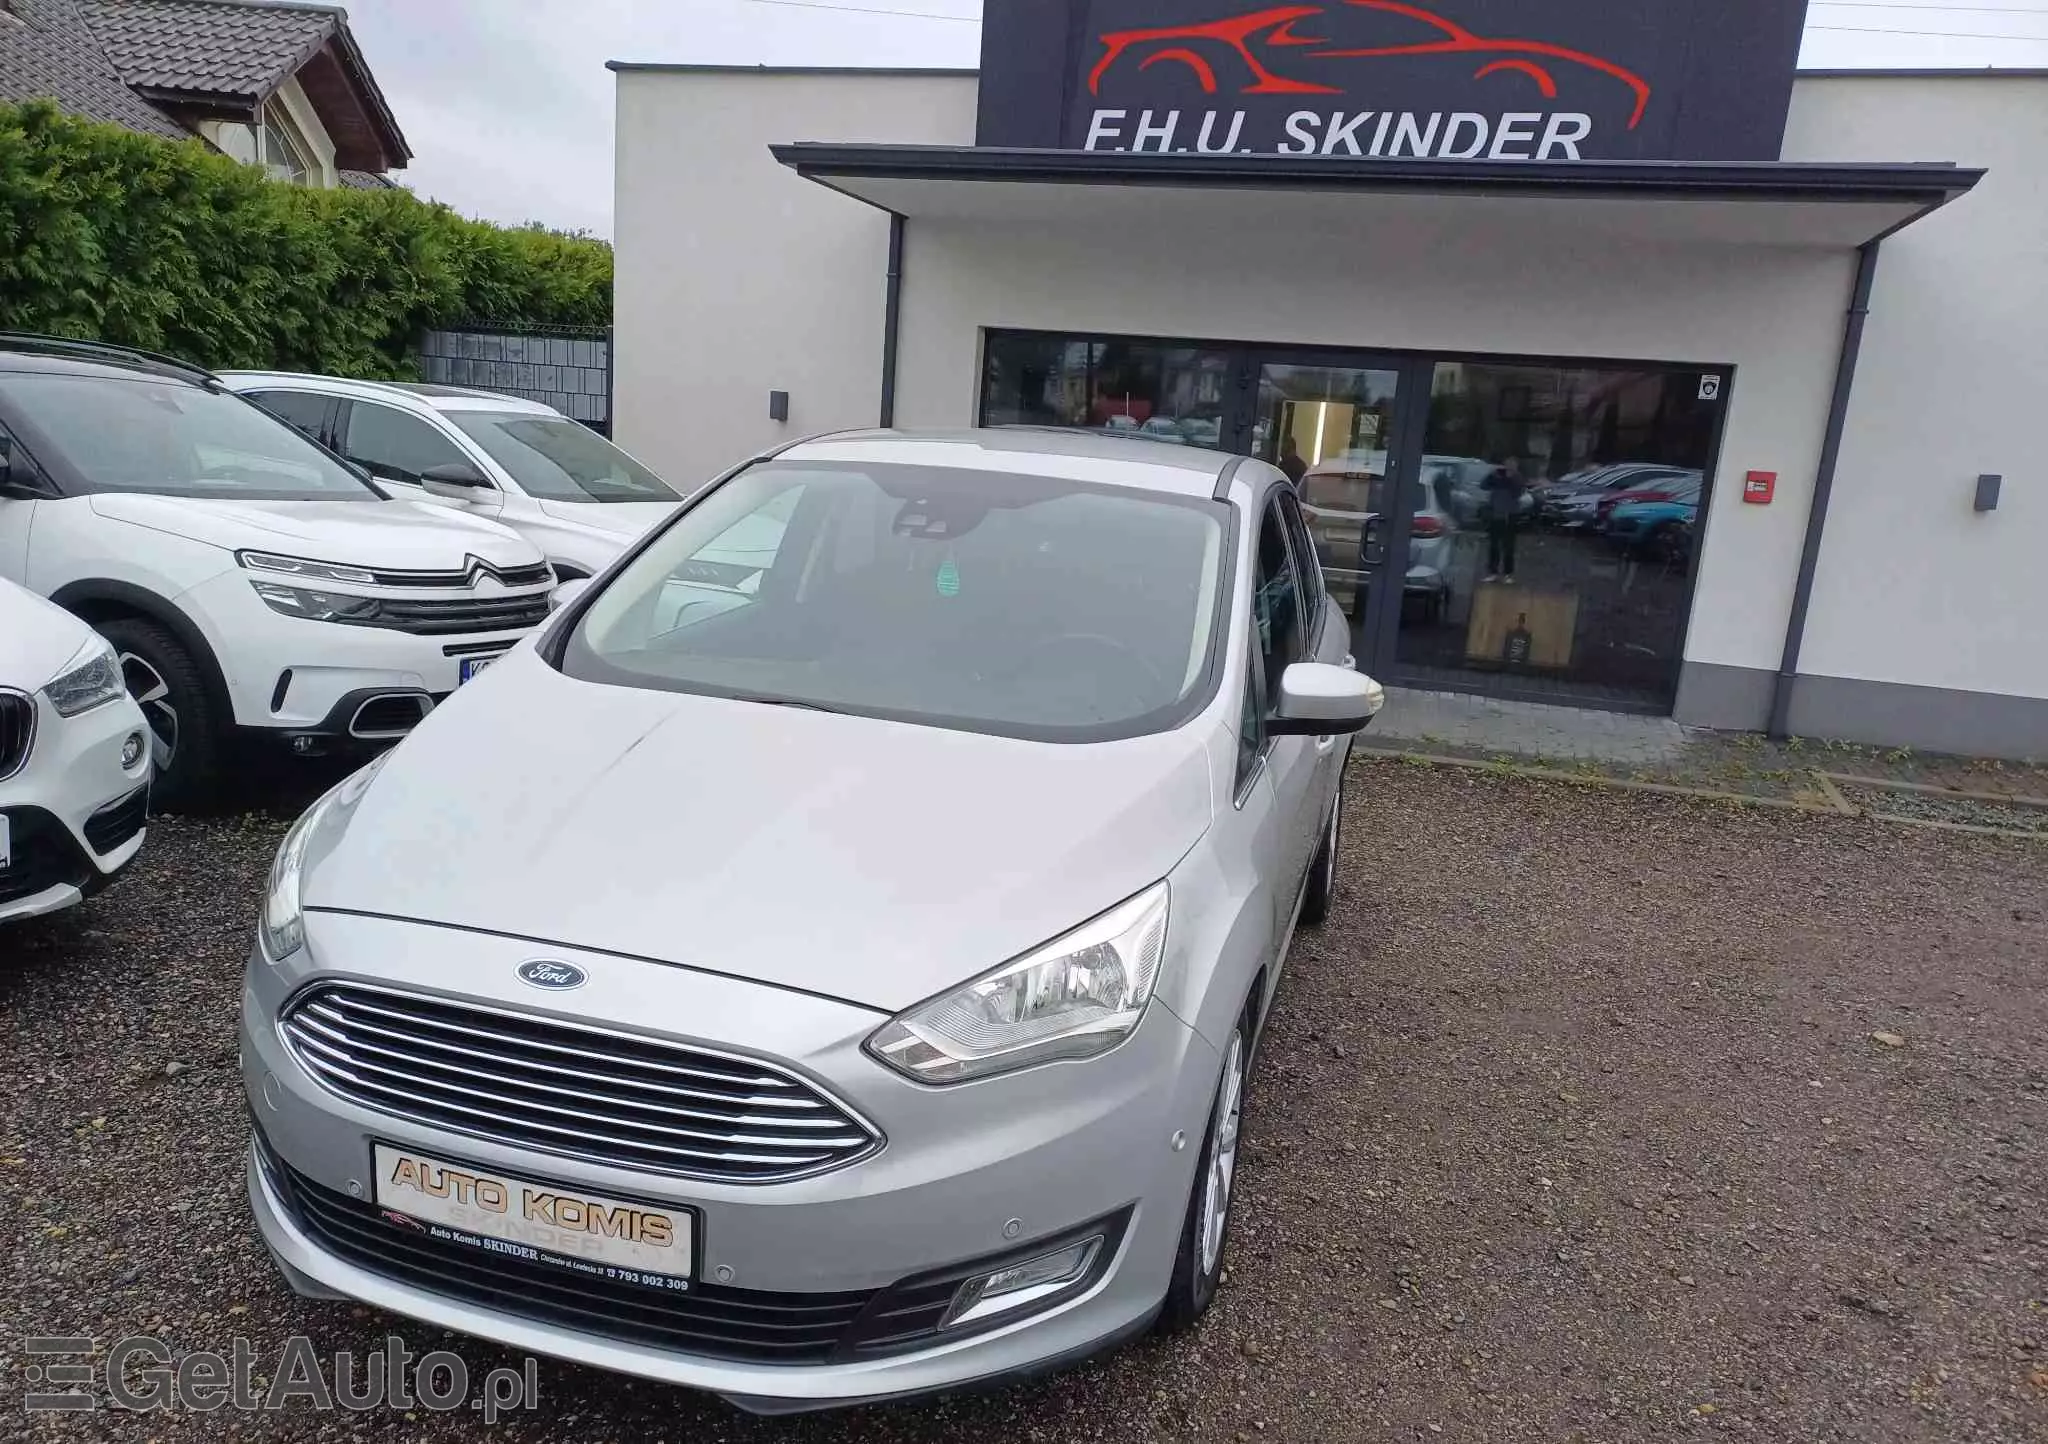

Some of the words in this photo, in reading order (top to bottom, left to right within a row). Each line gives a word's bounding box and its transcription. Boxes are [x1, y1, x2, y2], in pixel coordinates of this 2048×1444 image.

[1084, 109, 1252, 154] F.H.U.
[1277, 110, 1592, 161] SKINDER
[528, 963, 572, 984] Ford
[391, 1157, 508, 1214] AUTO
[522, 1189, 674, 1248] KOMIS
[430, 1226, 451, 1240] Auto
[453, 1231, 481, 1247] Komis
[483, 1238, 538, 1261] SKINDER
[618, 1270, 639, 1283] 793
[642, 1275, 664, 1288] 002
[666, 1279, 689, 1291] 309
